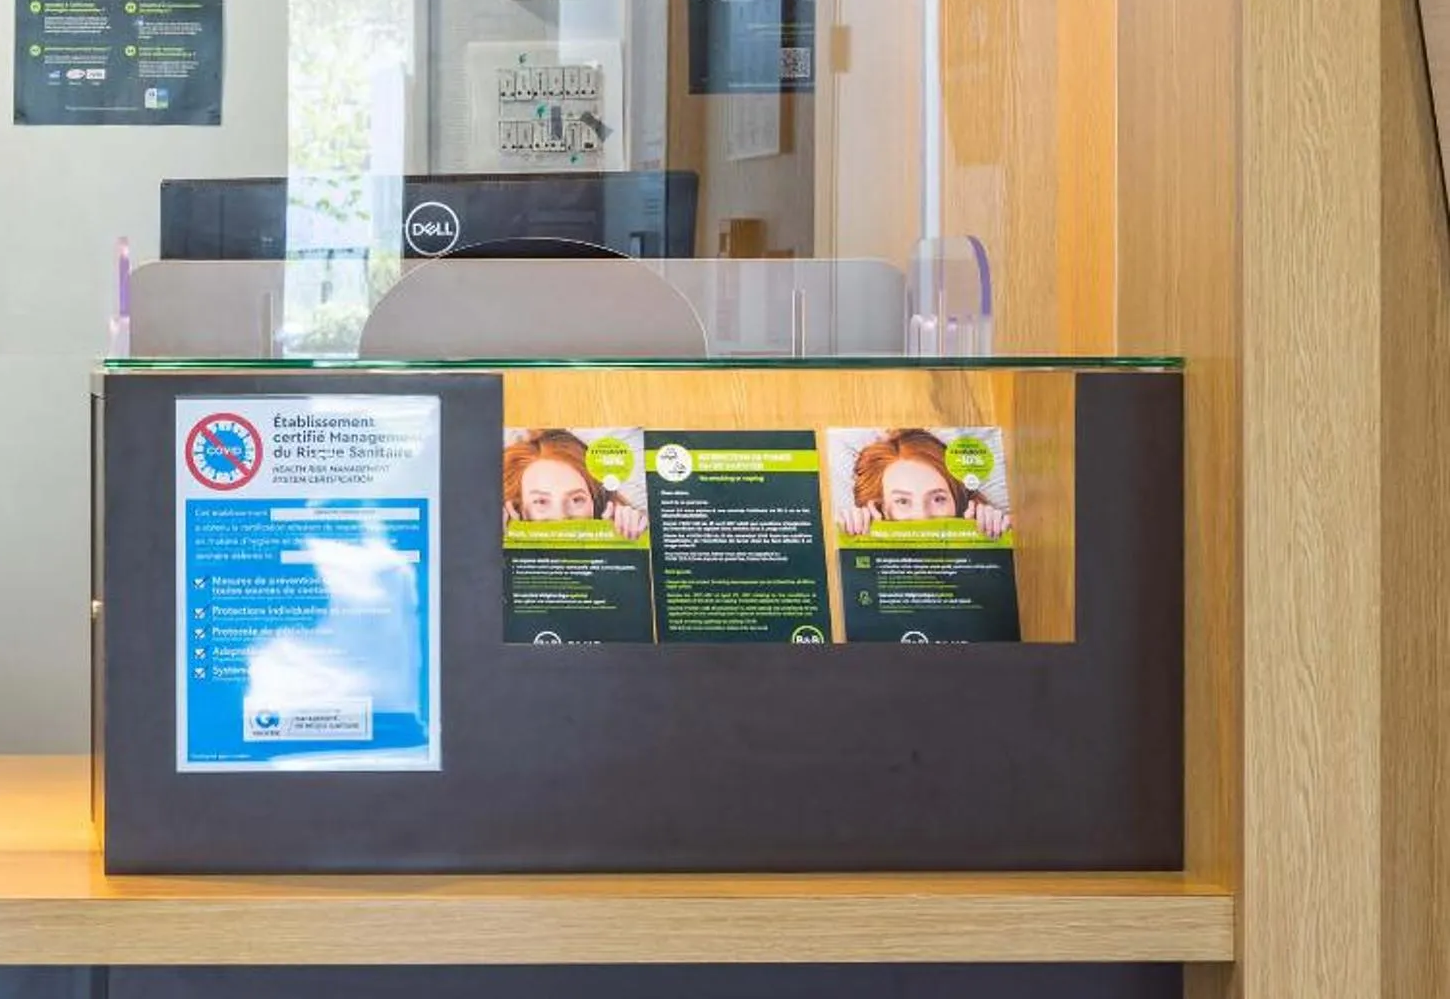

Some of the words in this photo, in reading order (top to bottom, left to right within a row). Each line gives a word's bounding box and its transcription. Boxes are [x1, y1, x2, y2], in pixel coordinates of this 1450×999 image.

[412, 221, 454, 237] DELL
[273, 413, 376, 428] Établissement
[272, 430, 326, 443] certifié
[273, 446, 291, 459] du
[297, 446, 345, 460] Risque
[349, 446, 413, 459] Sanitaire
[212, 605, 266, 616] Protections
